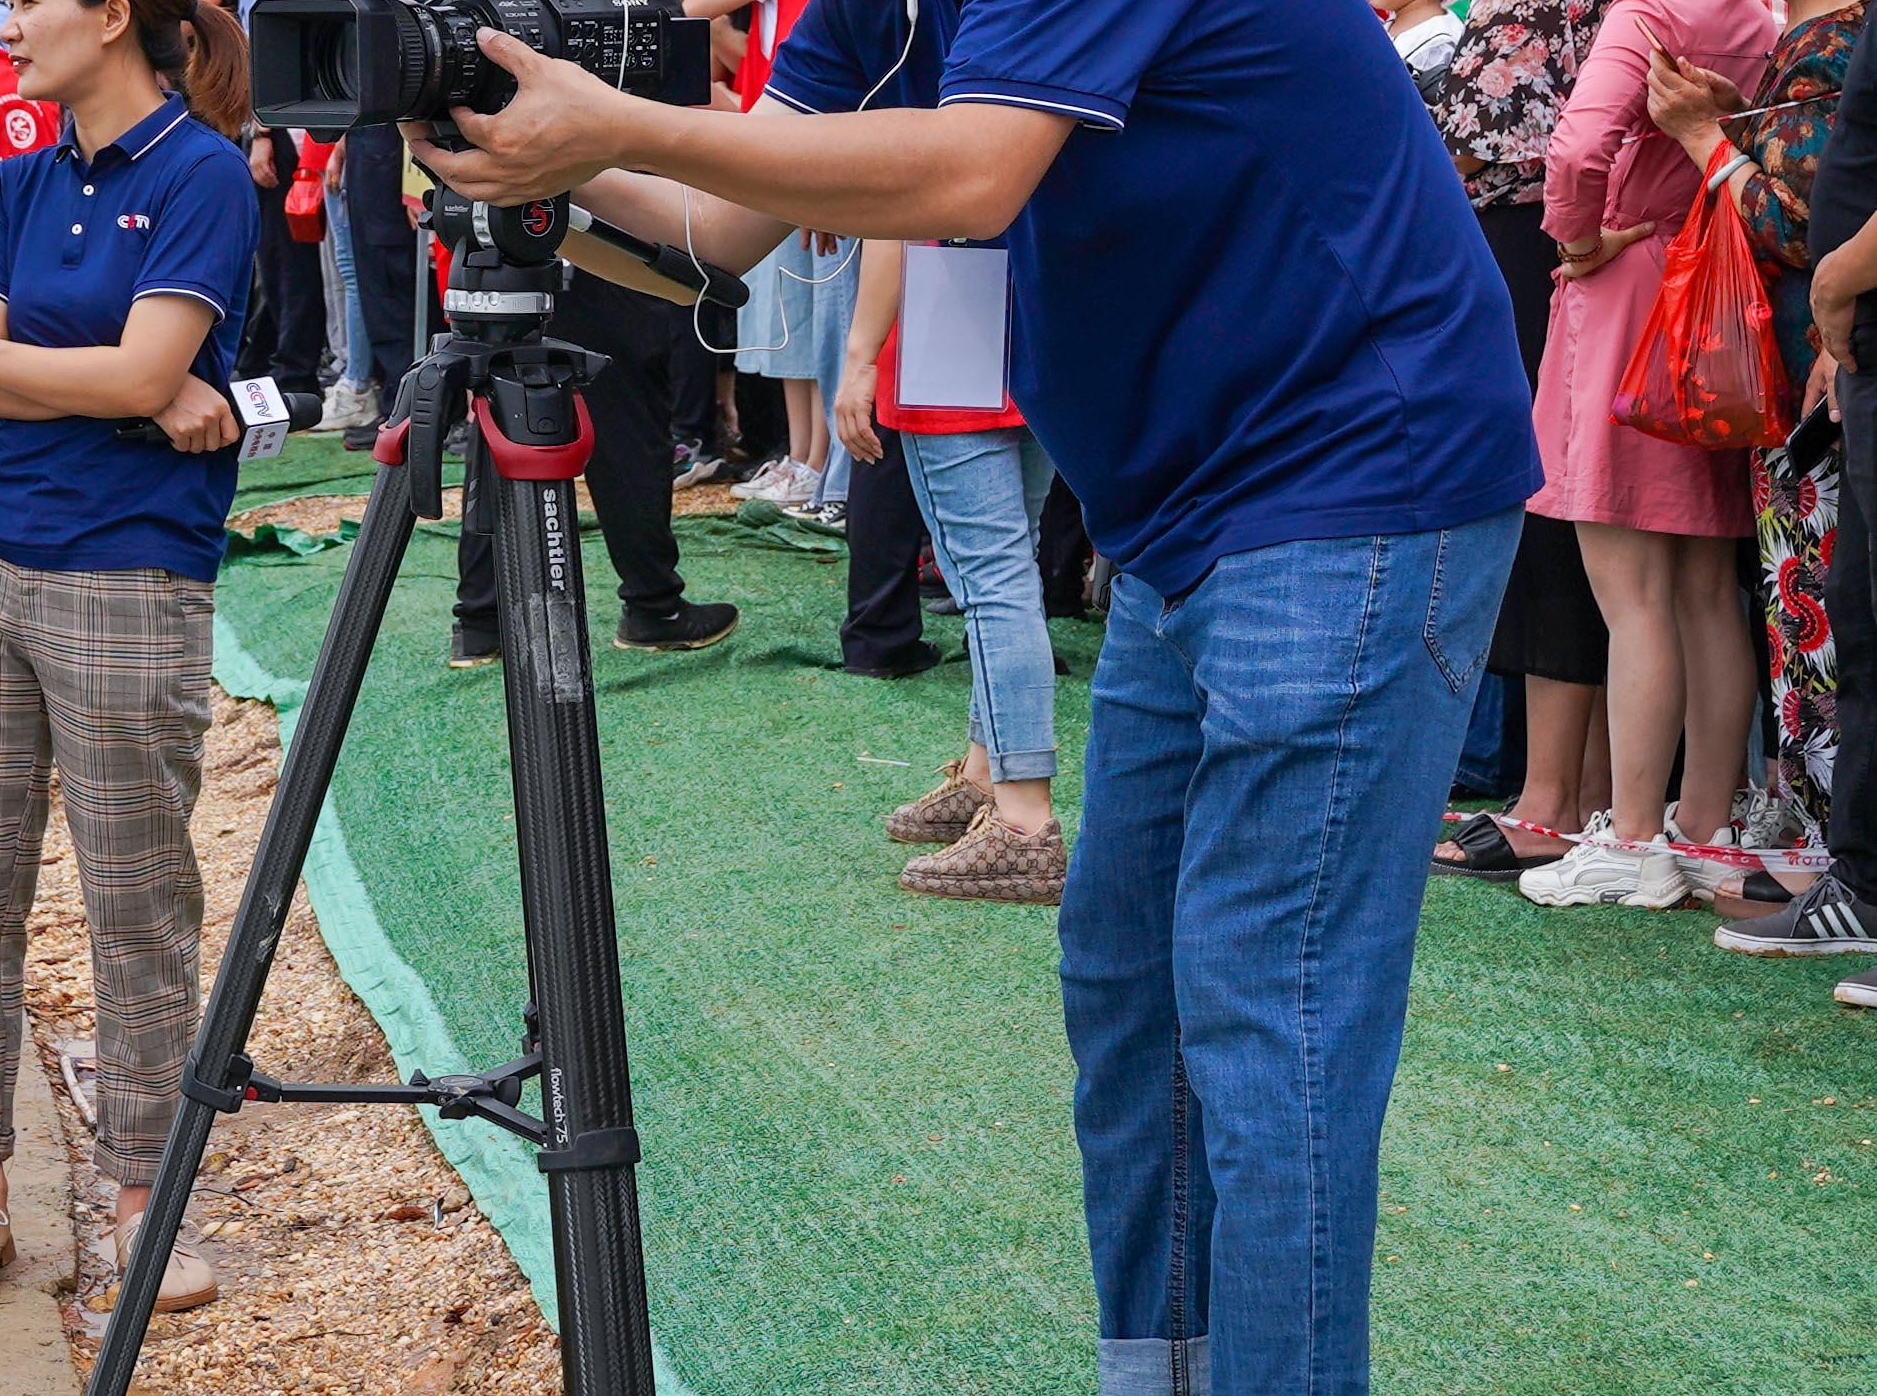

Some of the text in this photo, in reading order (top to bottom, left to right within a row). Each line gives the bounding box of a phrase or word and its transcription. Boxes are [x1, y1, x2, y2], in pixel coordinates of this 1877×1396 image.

[246, 382, 274, 417] CCTV
[543, 488, 566, 591] sachtler
[550, 1067, 569, 1144] flowtech 75
